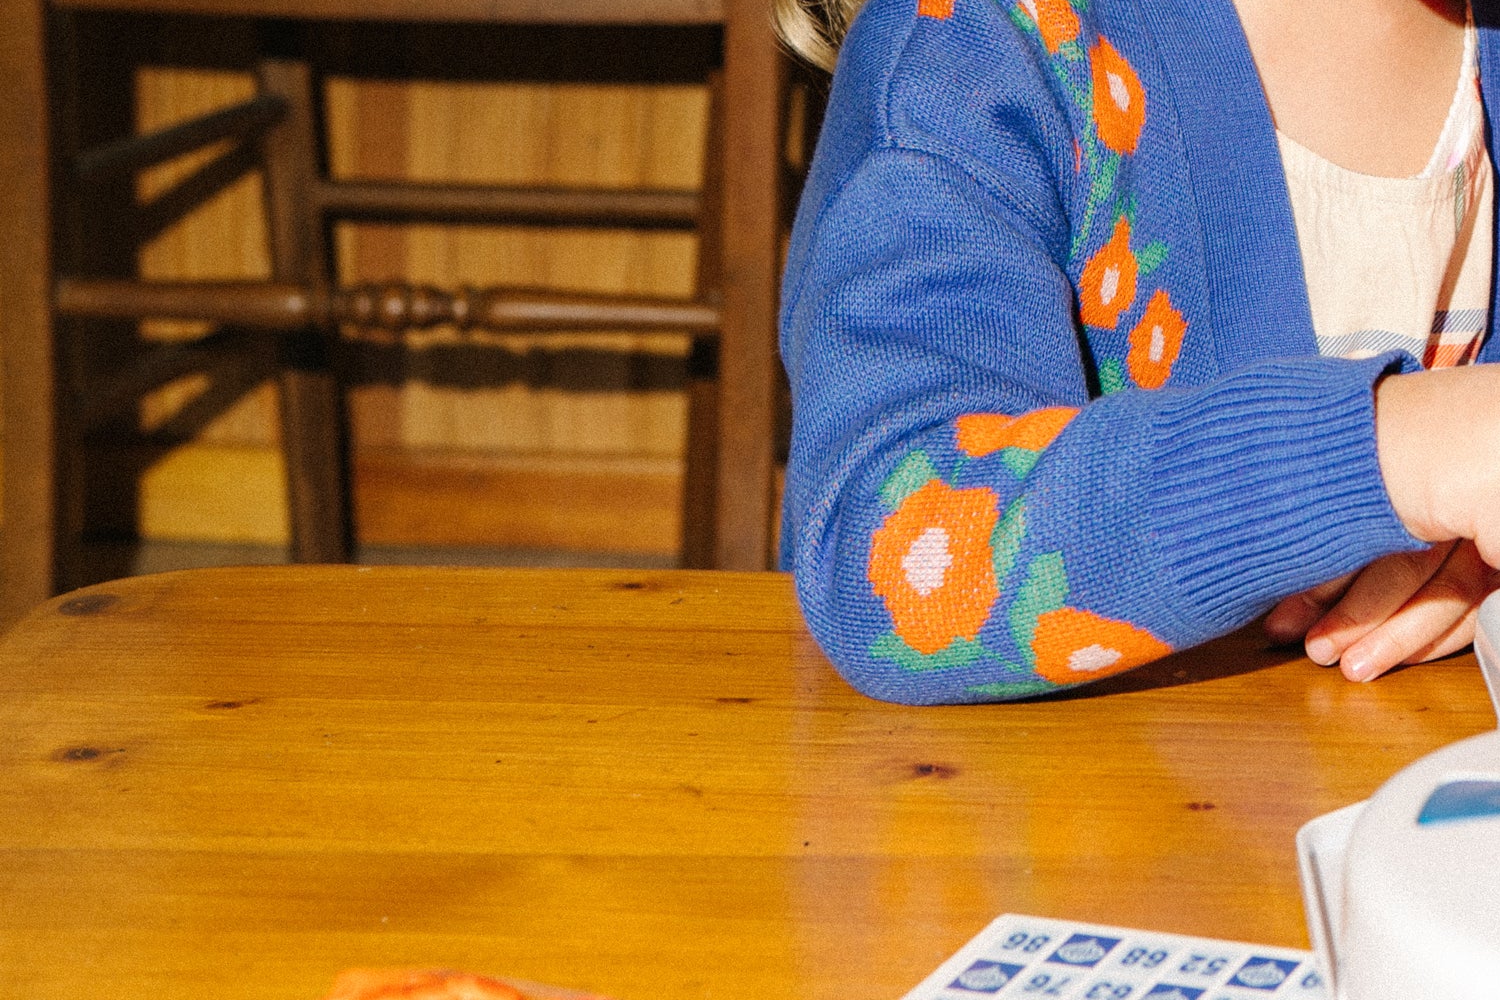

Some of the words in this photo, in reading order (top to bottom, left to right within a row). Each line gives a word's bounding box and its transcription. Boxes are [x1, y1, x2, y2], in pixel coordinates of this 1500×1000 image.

[1002, 931, 1050, 953] 86
[1121, 946, 1169, 969] 68
[1179, 954, 1228, 976] 52
[1023, 973, 1071, 997] 76
